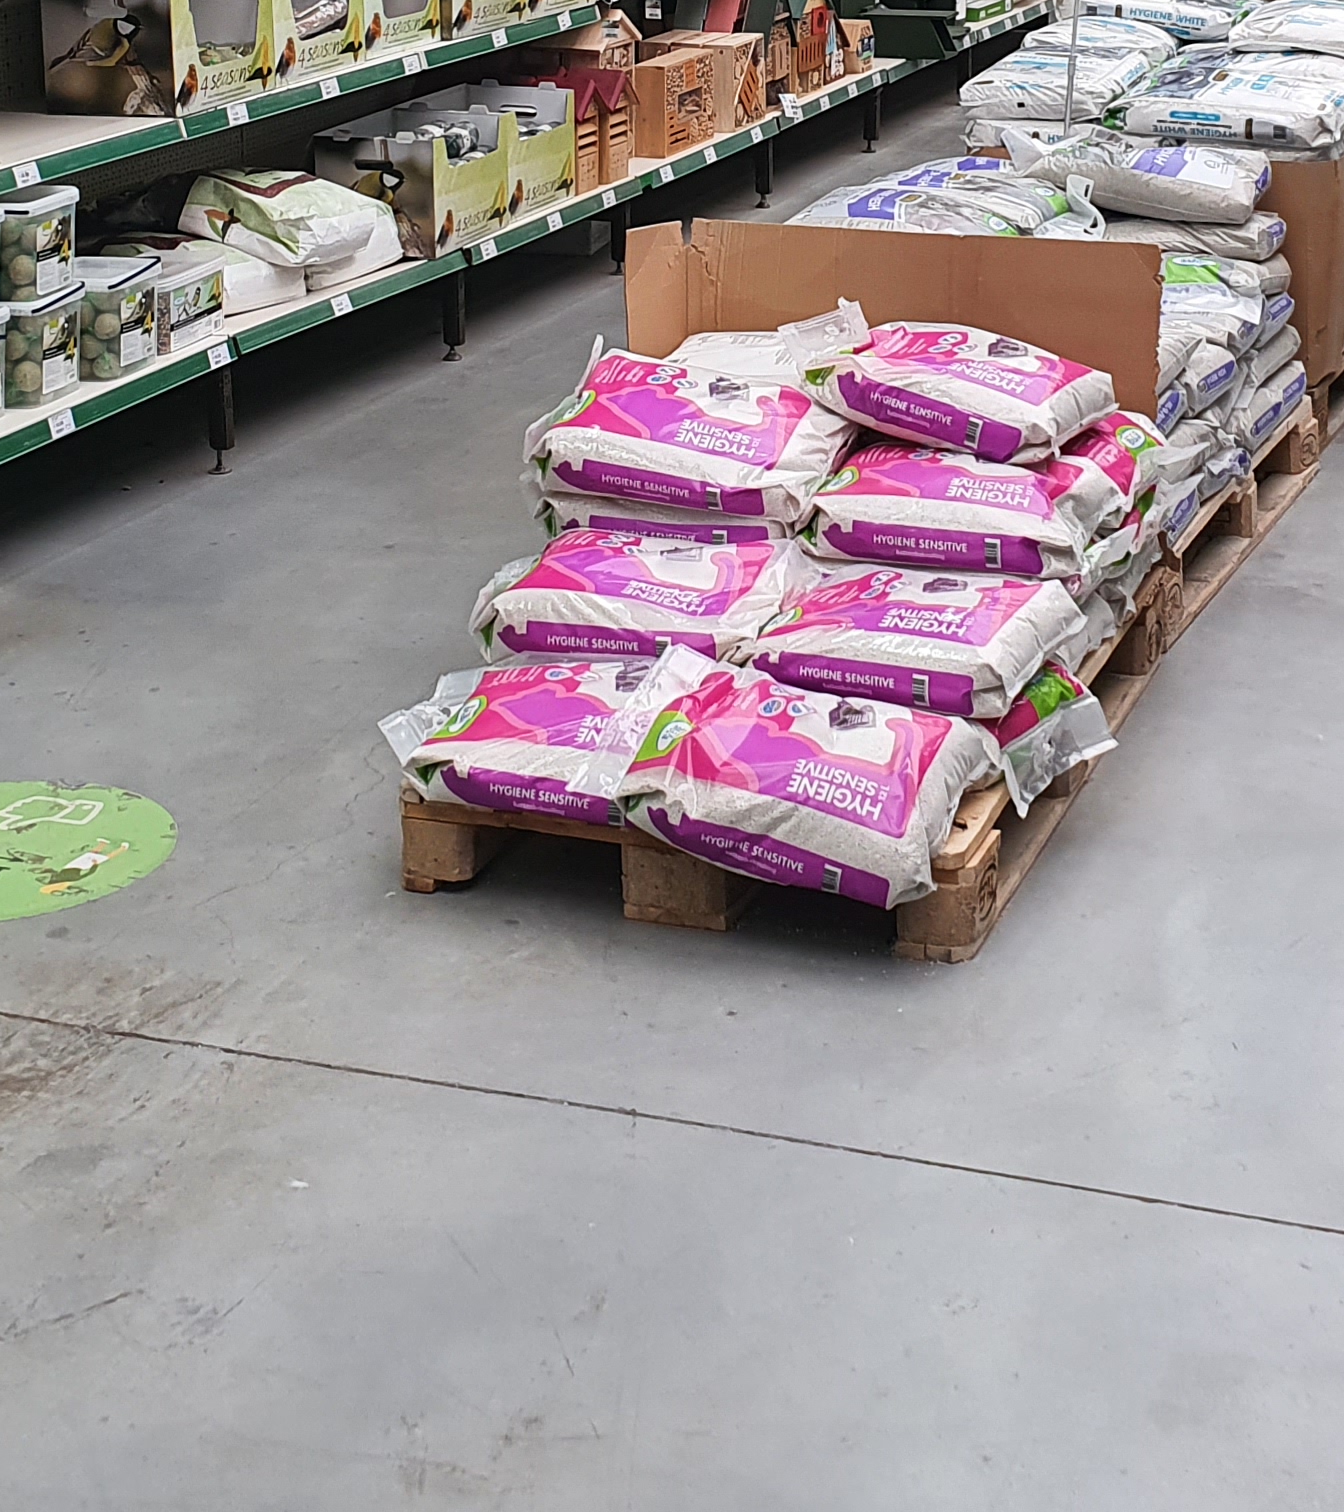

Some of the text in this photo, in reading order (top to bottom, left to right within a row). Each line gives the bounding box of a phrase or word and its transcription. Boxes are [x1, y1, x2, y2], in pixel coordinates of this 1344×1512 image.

[1130, 6, 1207, 28] HYGIENE WHITE
[1189, 126, 1238, 140] HYGIENE
[870, 390, 953, 427] HYGIENE SENSITIVE
[675, 417, 757, 460] HYGIENE SENSITIVE
[601, 473, 690, 498] HYGIENE SENSITIVE
[945, 476, 1031, 508] HYGIENE SENSITIVE
[874, 532, 968, 553] HYGIENE SENSITIVE
[878, 613, 971, 639] HYGIENE
[547, 634, 639, 652] HYGIENE SENSITIVE
[799, 665, 895, 688] HYGIENE SENSITIVE
[489, 781, 590, 810] HYGIENE SENSITIVE
[785, 758, 883, 822] HYGIENE SENSITIVE
[752, 843, 804, 873] SENSITIVE
